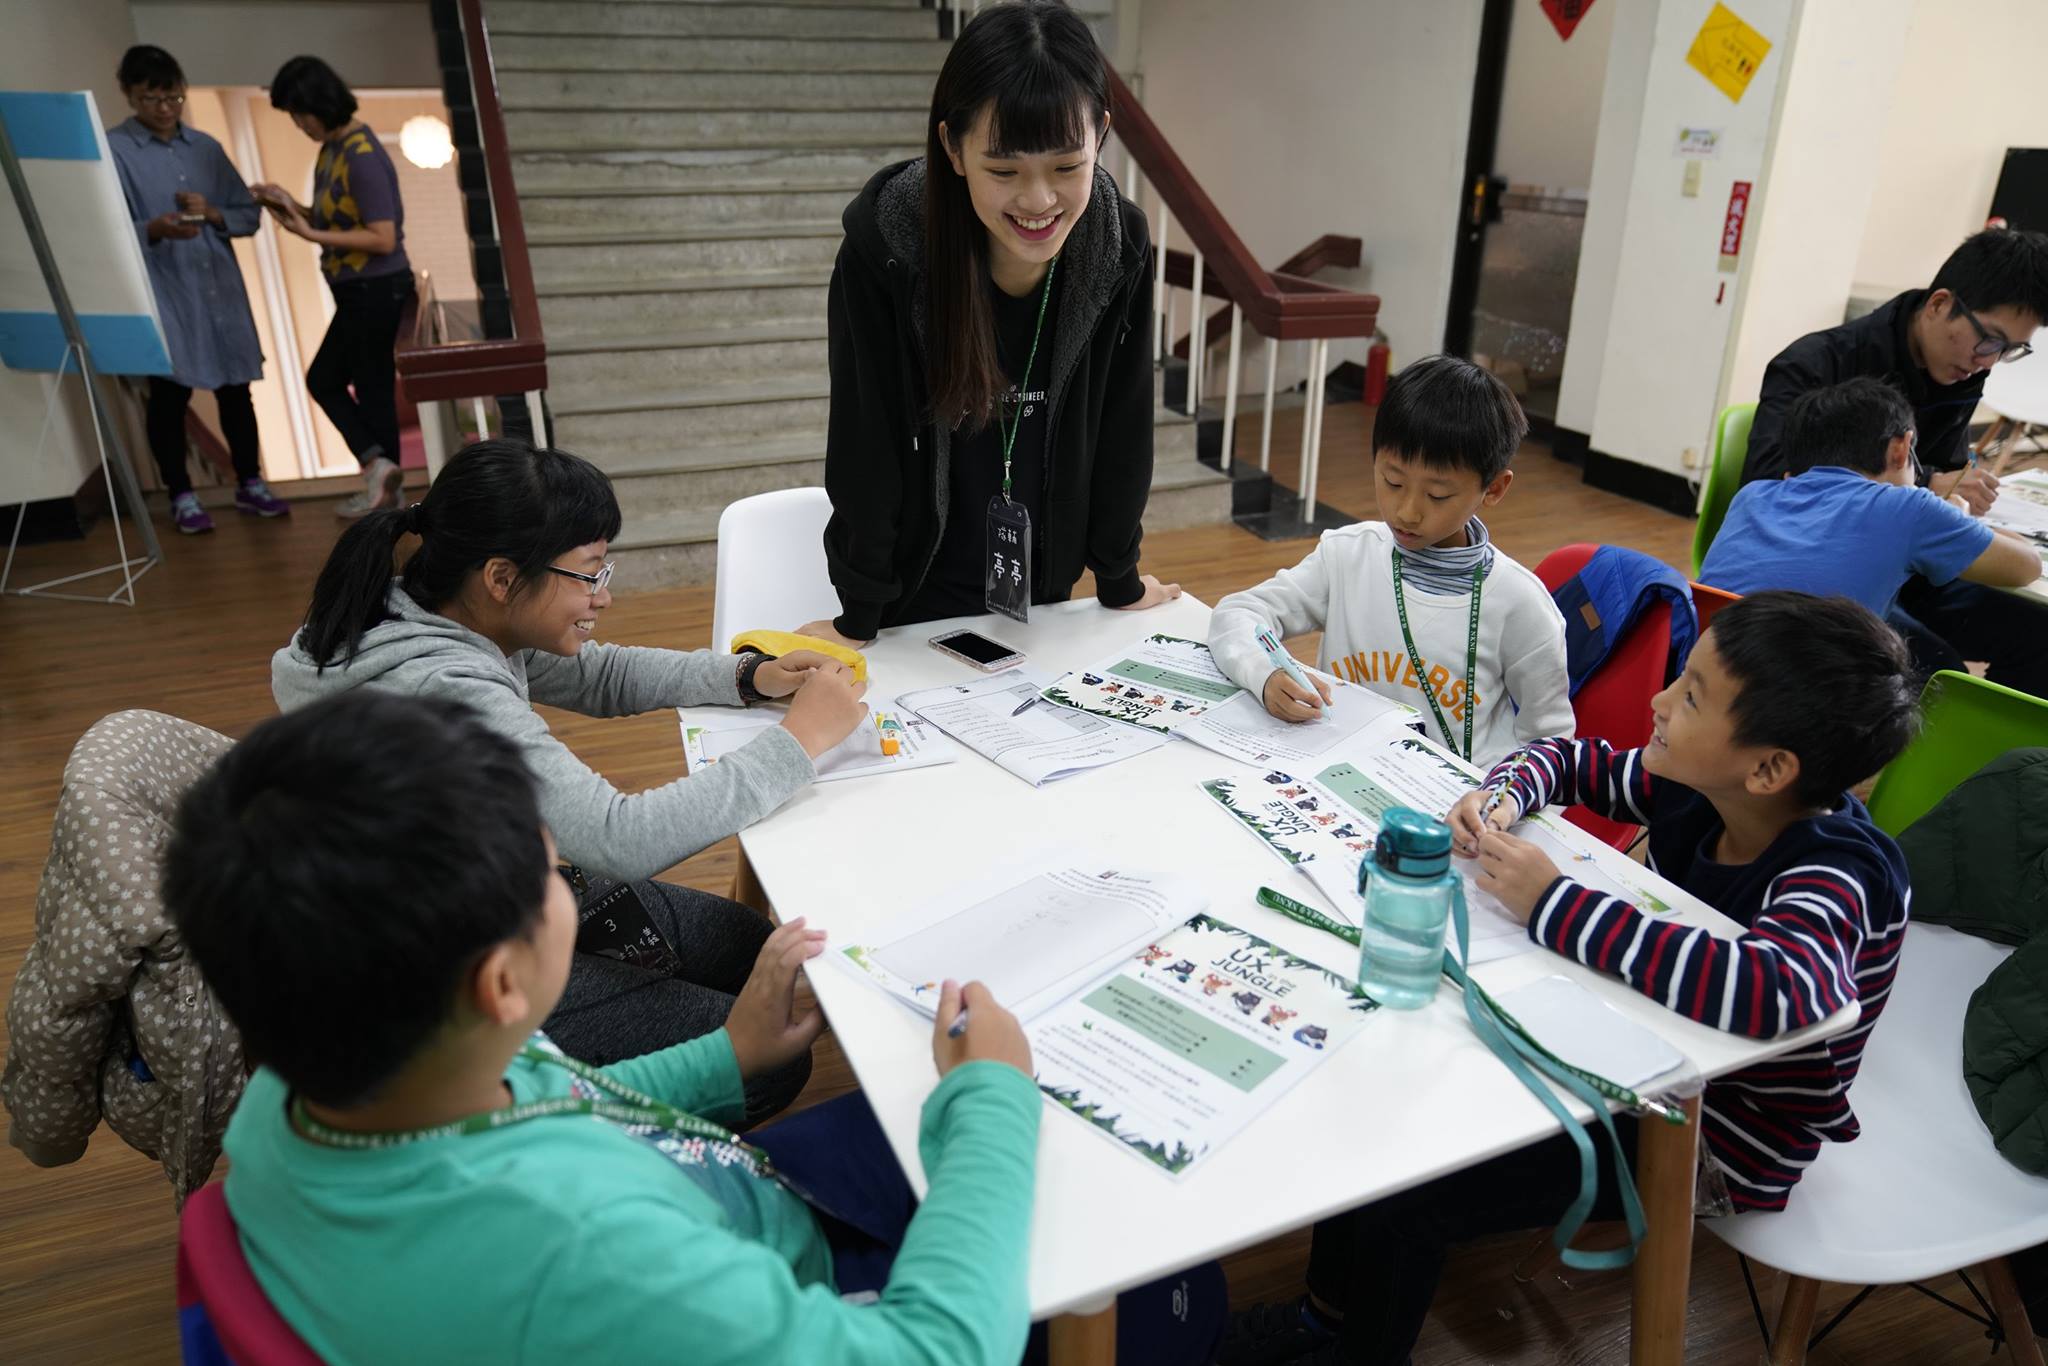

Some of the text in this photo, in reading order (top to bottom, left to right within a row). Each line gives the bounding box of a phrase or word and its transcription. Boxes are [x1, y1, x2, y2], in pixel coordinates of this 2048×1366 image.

[1469, 628, 1478, 653] NKNU
[1408, 642, 1419, 667] NKNU
[1331, 651, 1481, 722] UNIVERSE
[1105, 696, 1162, 713] JUNGLE
[1463, 713, 1473, 738] NKNU
[1268, 800, 1317, 833] JUNGLE
[1268, 817, 1299, 836] UX
[604, 918, 617, 933] 3
[1230, 948, 1271, 974] UX
[1211, 959, 1292, 998] JUNGLE
